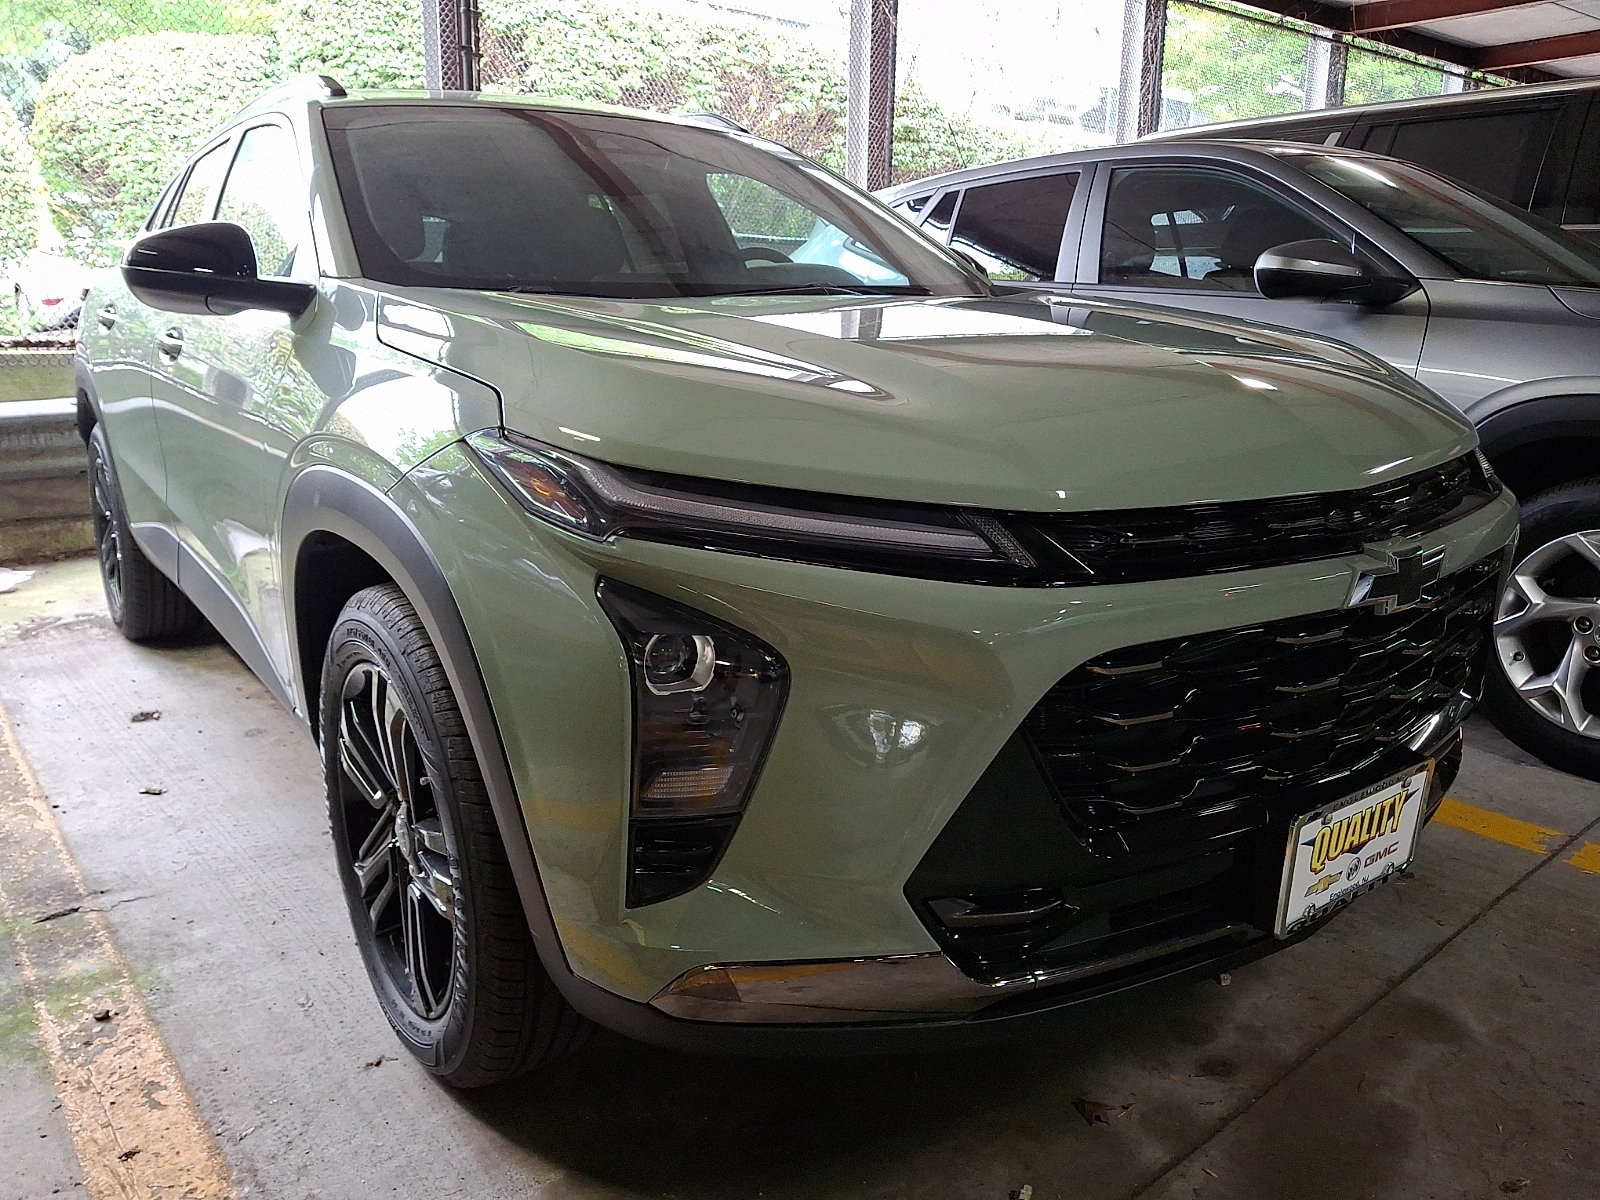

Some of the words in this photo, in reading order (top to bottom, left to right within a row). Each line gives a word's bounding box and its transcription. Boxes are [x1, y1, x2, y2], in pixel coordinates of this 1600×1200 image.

[1332, 779, 1395, 811] ENGLEWOOD
[1310, 789, 1409, 875] QUALITY
[1364, 841, 1400, 869] GMC
[1362, 874, 1370, 884] NJ
